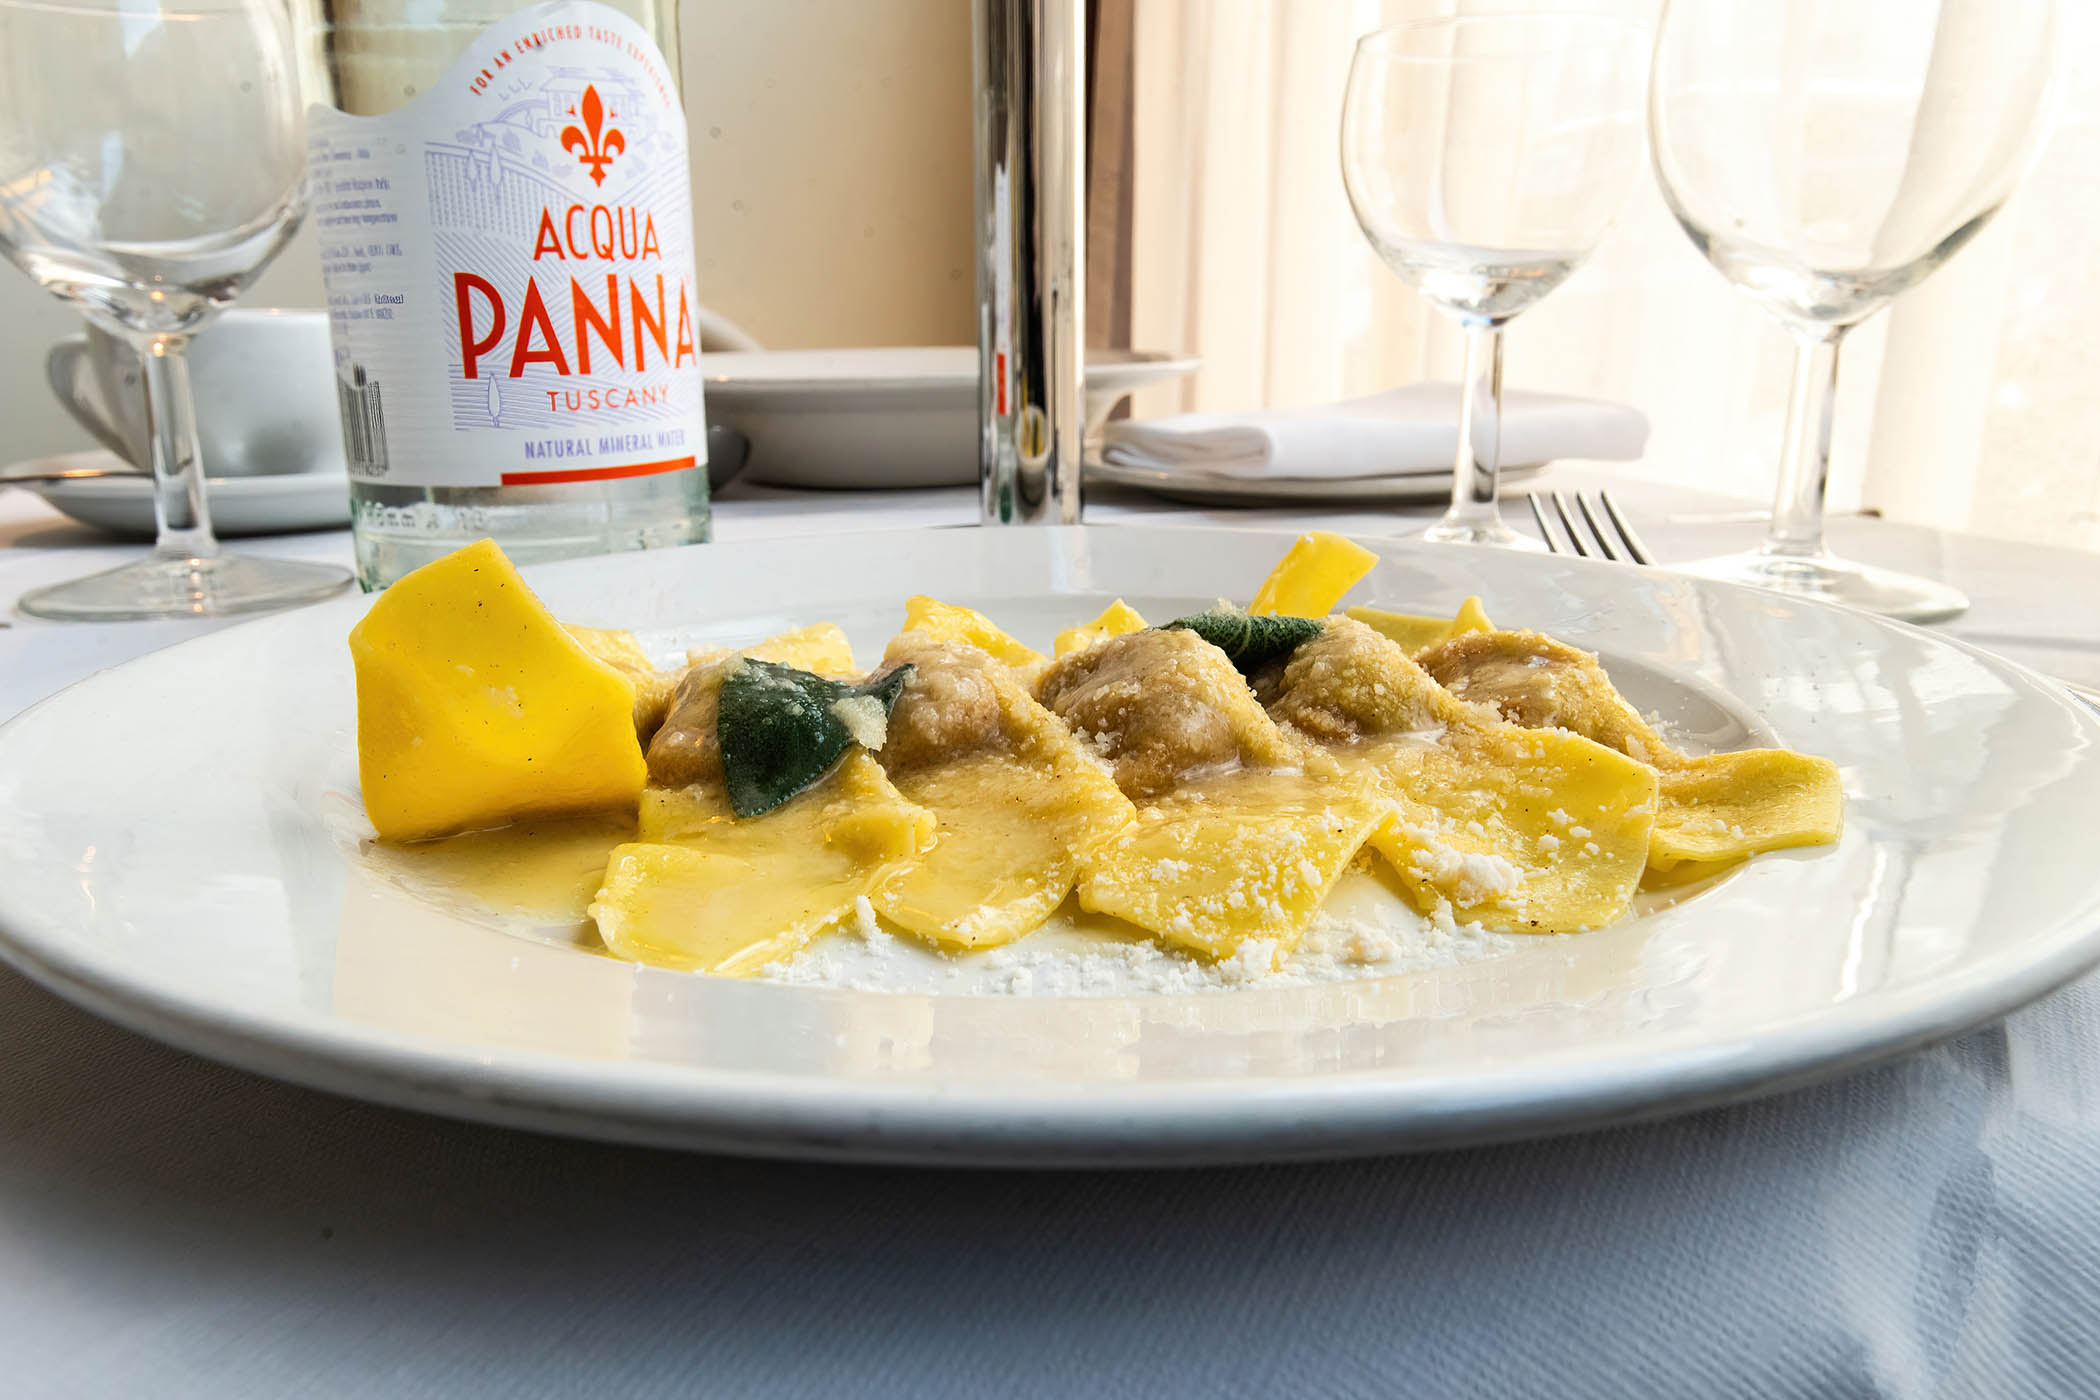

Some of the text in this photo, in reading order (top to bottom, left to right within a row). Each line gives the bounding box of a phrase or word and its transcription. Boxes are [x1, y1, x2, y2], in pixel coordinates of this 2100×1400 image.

[469, 68, 494, 96] FOR
[493, 49, 512, 69] AN
[514, 24, 582, 54] ENRICHED
[588, 25, 622, 49] TASTE
[533, 204, 661, 262] ACQUA
[454, 272, 697, 379] PANNA
[546, 384, 668, 411] TUSCANY
[524, 429, 686, 459] NATURAL MINERAL WATER
